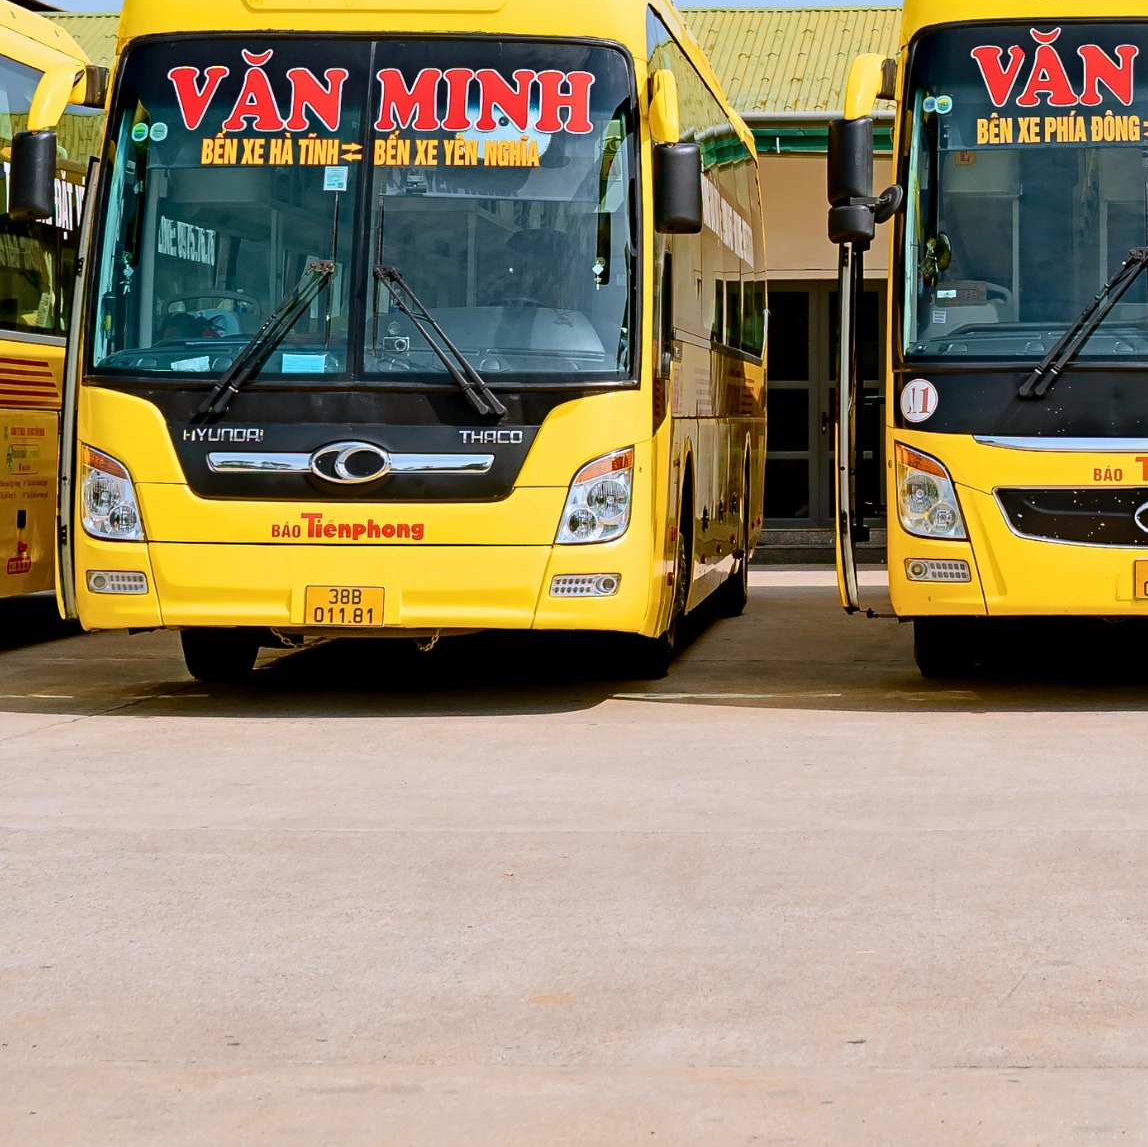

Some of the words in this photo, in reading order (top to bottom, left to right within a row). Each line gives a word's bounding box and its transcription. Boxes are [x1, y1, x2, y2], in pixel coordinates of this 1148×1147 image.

[971, 27, 1139, 107] VĂN
[167, 48, 348, 133] VĂN
[374, 68, 595, 134] MINH
[1018, 117, 1040, 143] XE
[1044, 111, 1087, 142] PHÍA
[1091, 110, 1140, 142] ĐÔNG
[201, 129, 238, 165] BẾN
[240, 138, 266, 165] XE
[268, 132, 294, 165] HÀ
[298, 132, 339, 165] TĨNH
[373, 130, 411, 166] BẾN
[413, 139, 439, 166] XE
[443, 133, 479, 166] YÊN
[483, 135, 540, 167] NGHĨA
[458, 430, 525, 444] THACO
[1093, 465, 1123, 482] BÁO
[271, 521, 301, 538] BÁO
[328, 588, 362, 605] 38B
[314, 607, 374, 624] 011.81
